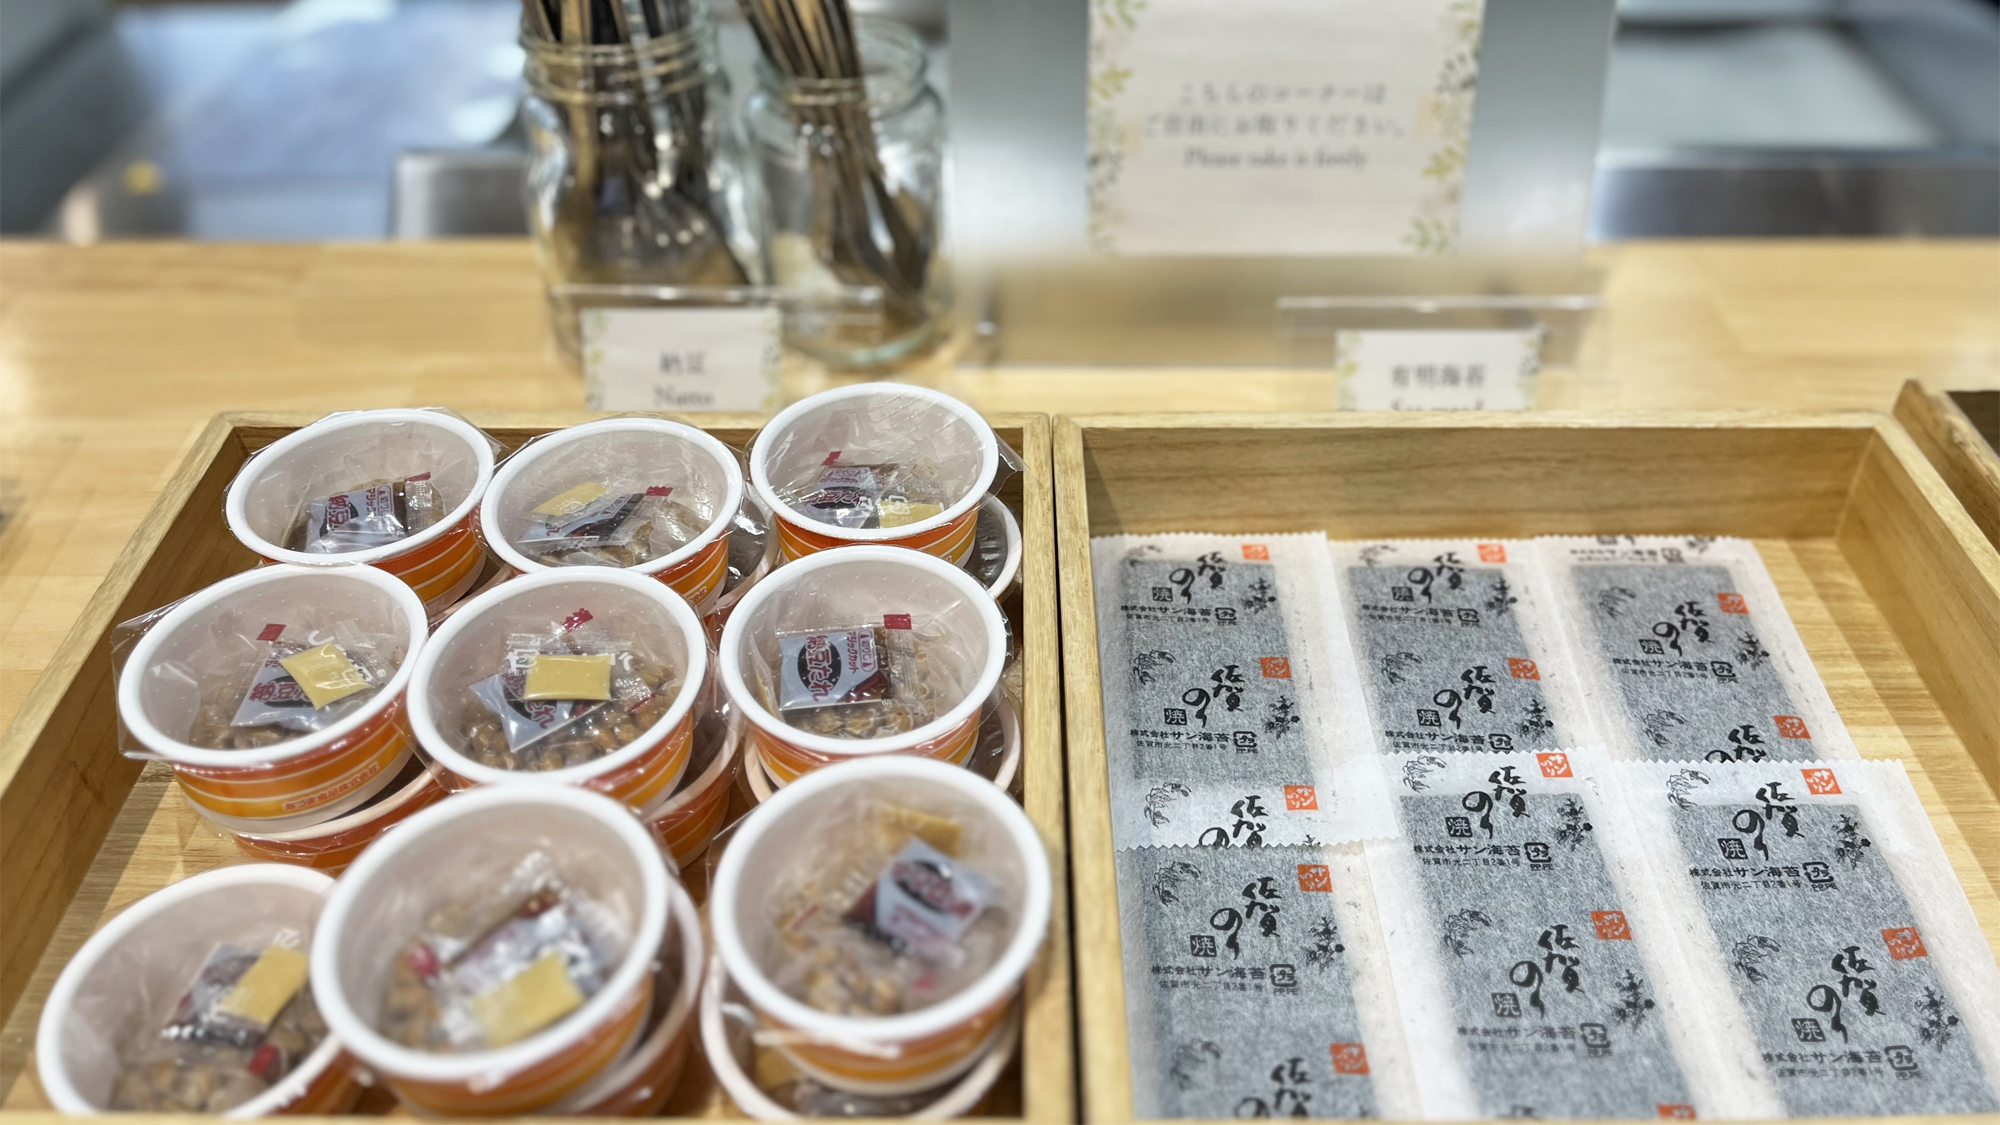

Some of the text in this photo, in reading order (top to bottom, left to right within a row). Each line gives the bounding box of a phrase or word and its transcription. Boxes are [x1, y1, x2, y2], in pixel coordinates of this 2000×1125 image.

[1184, 147, 1240, 168] Please
[1164, 707, 1187, 725] 焼
[1416, 709, 1441, 727] 焼
[1489, 764, 1531, 818] 佐賀
[1756, 781, 1805, 838] 佐賀
[1445, 816, 1472, 837] 焼
[1413, 844, 1521, 856] 株式会社サン海苔
[1717, 838, 1748, 860] 焼
[1689, 865, 1801, 878] 株式会社サン海苔
[1242, 876, 1282, 938] 佐賀
[1190, 935, 1217, 958] 焼
[1537, 923, 1585, 994] 佐賀
[1151, 965, 1266, 980] 株式会社サン海苔
[1831, 945, 1886, 1016] 佐賀
[1491, 992, 1522, 1017] 焼
[1791, 1017, 1827, 1042] 焼
